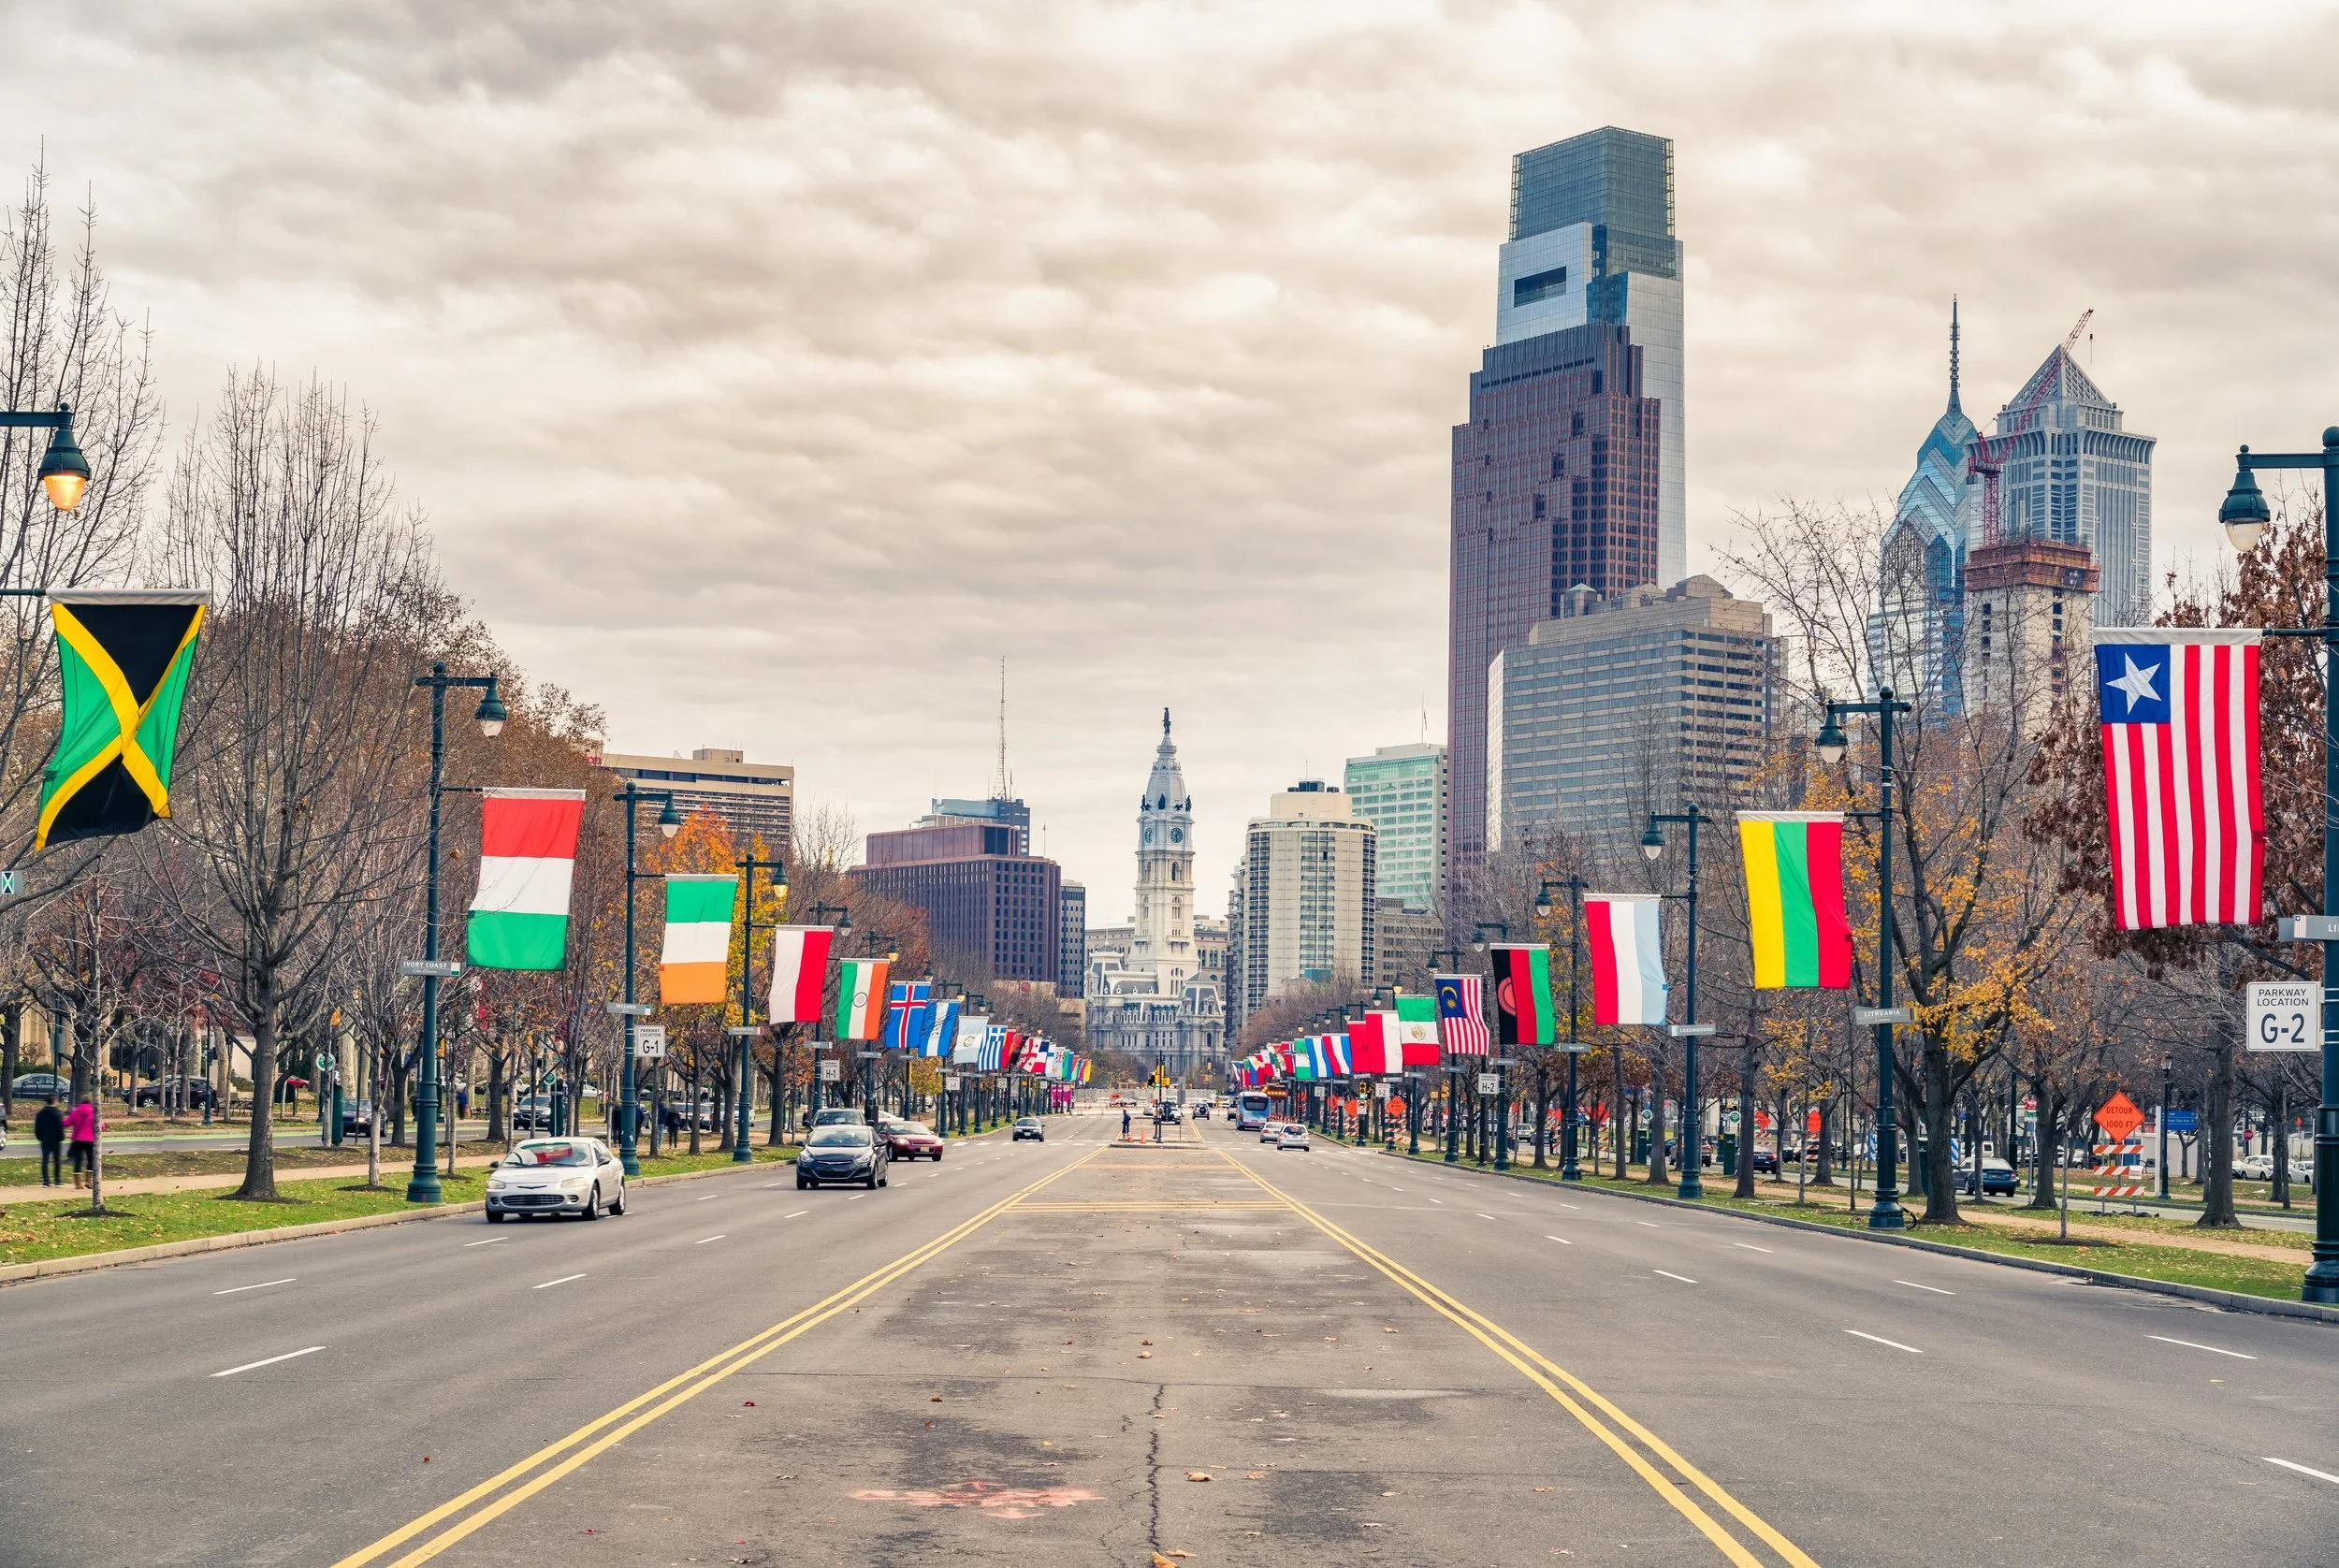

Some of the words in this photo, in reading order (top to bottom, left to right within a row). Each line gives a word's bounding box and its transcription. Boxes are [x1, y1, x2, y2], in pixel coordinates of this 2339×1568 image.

[2259, 988, 2307, 997] PARKWAY
[2257, 998, 2309, 1007] LOCATION
[1864, 1009, 1901, 1018] LITHUANIA
[2260, 1013, 2305, 1044] G-2
[643, 1039, 659, 1054] G-1
[826, 1069, 836, 1079] H-1
[1482, 1082, 1495, 1093] H-2
[2106, 1107, 2133, 1115] DETOUR
[2126, 1120, 2134, 1128] FT
